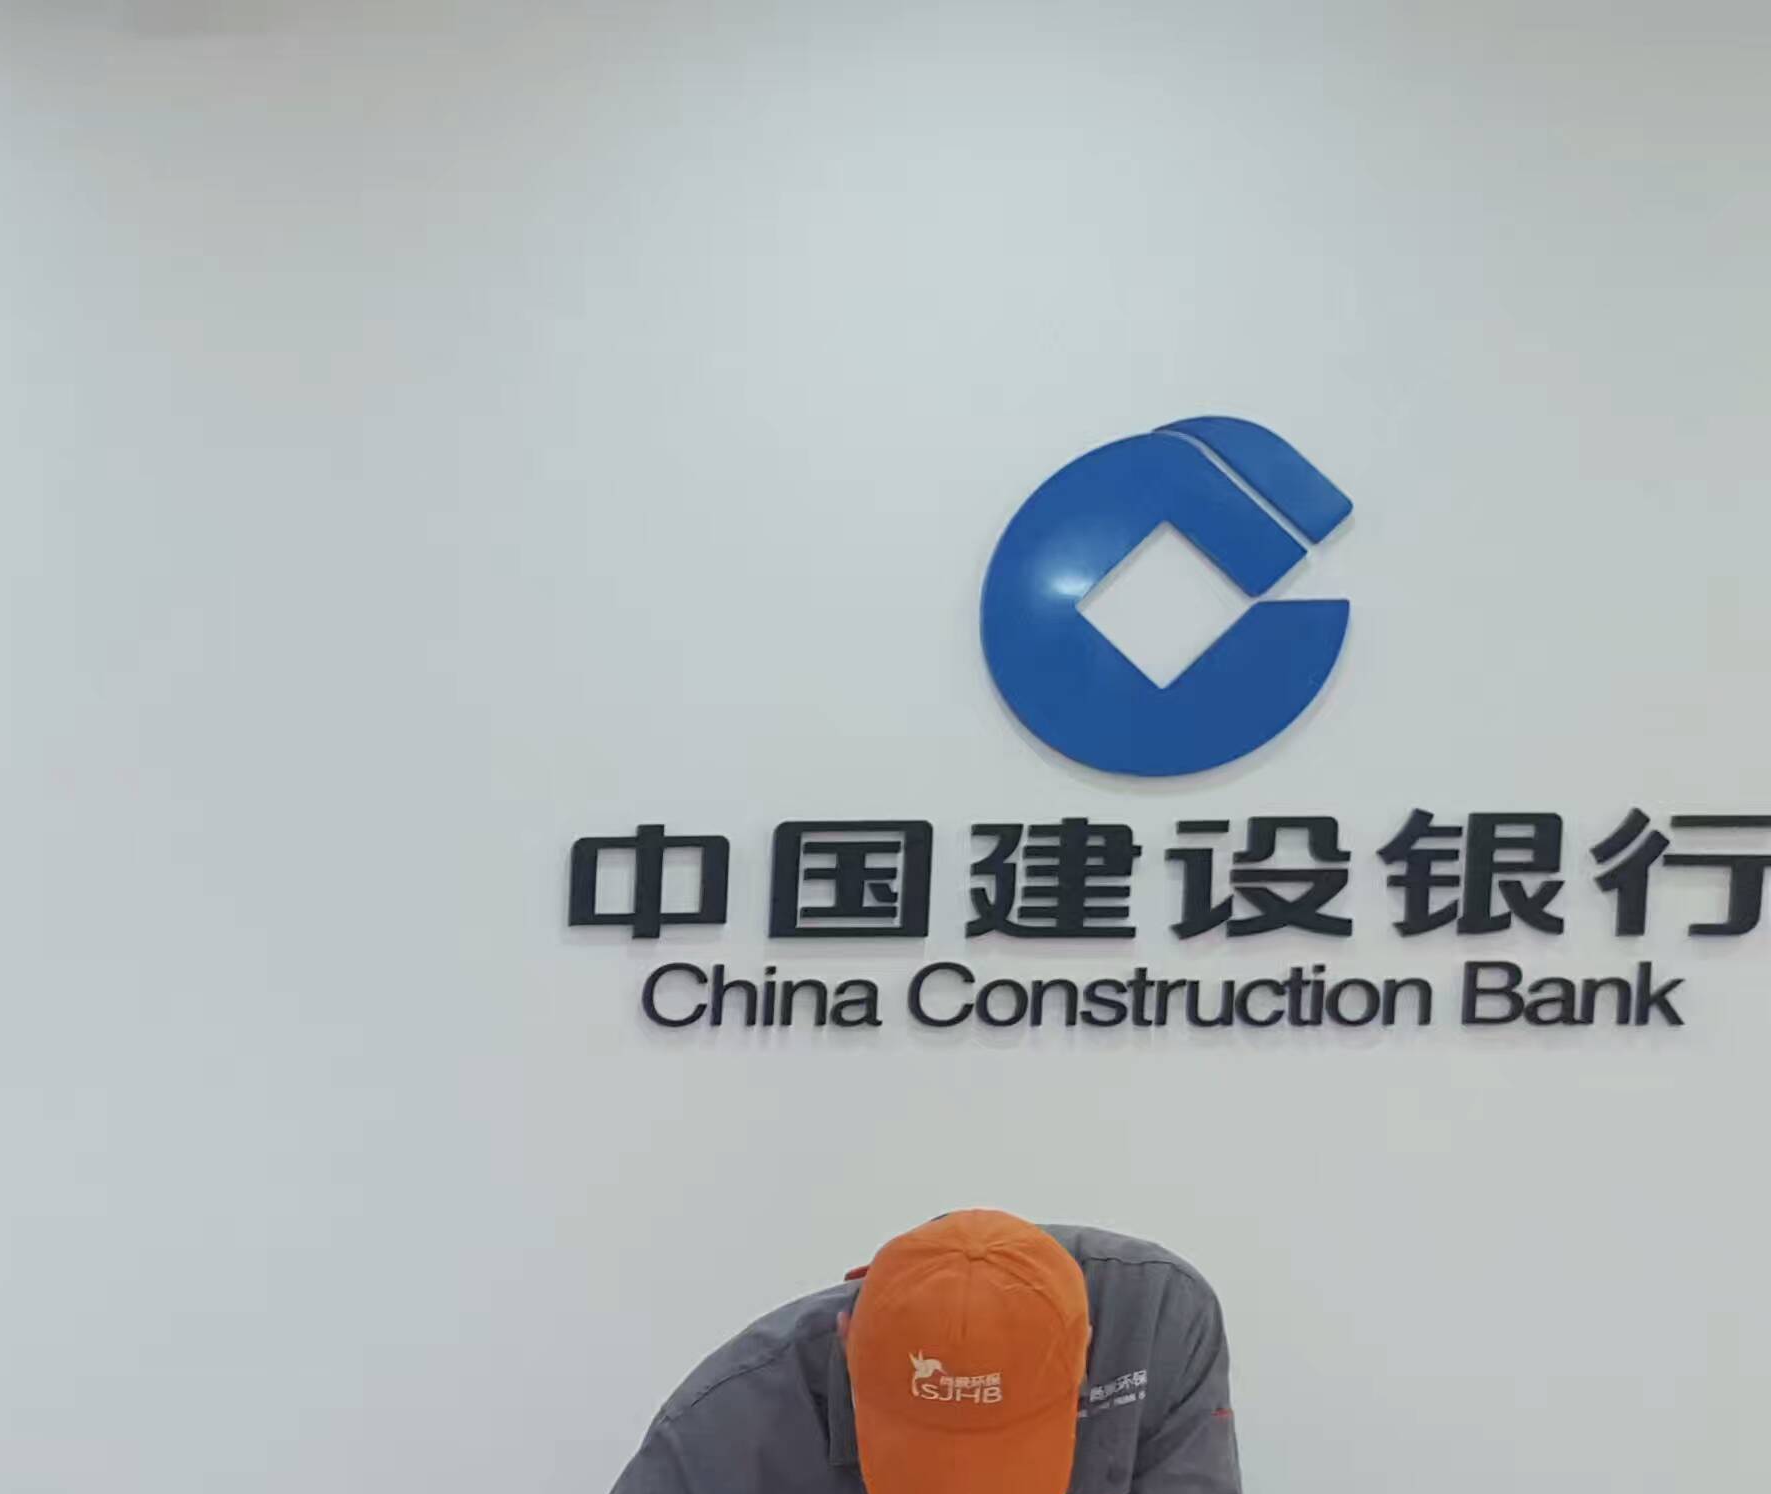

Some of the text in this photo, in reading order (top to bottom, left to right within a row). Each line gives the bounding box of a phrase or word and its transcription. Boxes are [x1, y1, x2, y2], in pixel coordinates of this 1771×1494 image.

[567, 806, 1771, 941] 中国建设银行
[641, 957, 1686, 1030] China Construction Bank
[921, 1383, 1004, 1404] SJHB
